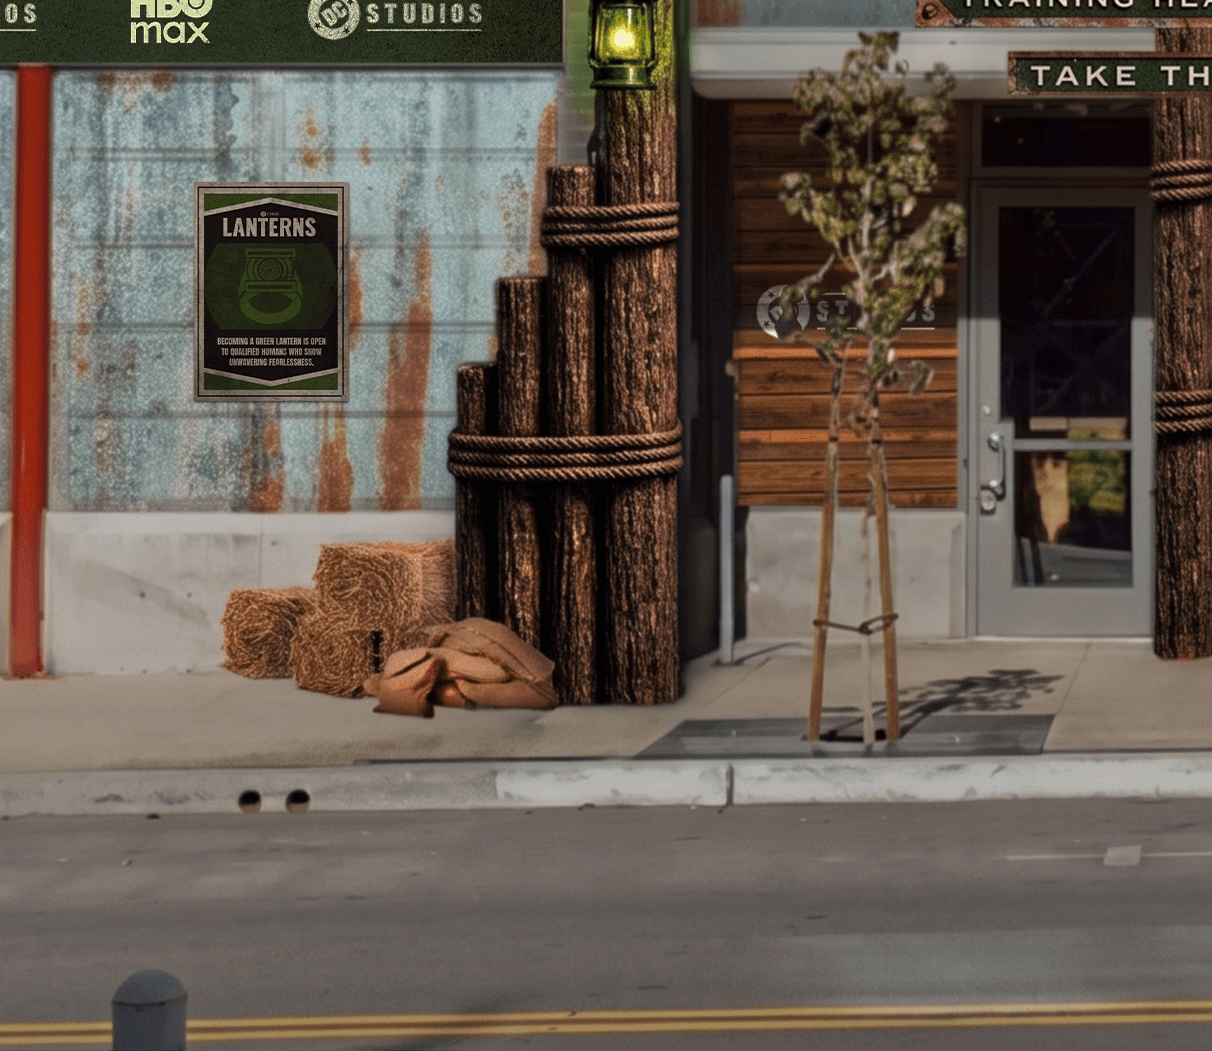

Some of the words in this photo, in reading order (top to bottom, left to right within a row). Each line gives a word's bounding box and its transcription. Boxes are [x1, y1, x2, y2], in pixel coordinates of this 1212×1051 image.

[320, 0, 349, 26] DC
[366, 2, 482, 24] STUDIOS
[130, 21, 211, 44] max
[1030, 65, 1137, 87] TAKE
[222, 217, 317, 238] LANTERNS
[217, 337, 249, 346] BECOMING
[249, 337, 255, 346] A
[255, 337, 274, 346] GREEN
[275, 337, 302, 346] LANTERN
[303, 337, 310, 346] IS
[310, 337, 327, 346] OPEN
[221, 347, 230, 356] TO
[230, 347, 260, 357] QUALIFIED
[261, 347, 288, 356] HUMANS
[288, 347, 303, 356] WHO
[304, 347, 322, 356] SHOW
[229, 357, 268, 367] UNWAVERING
